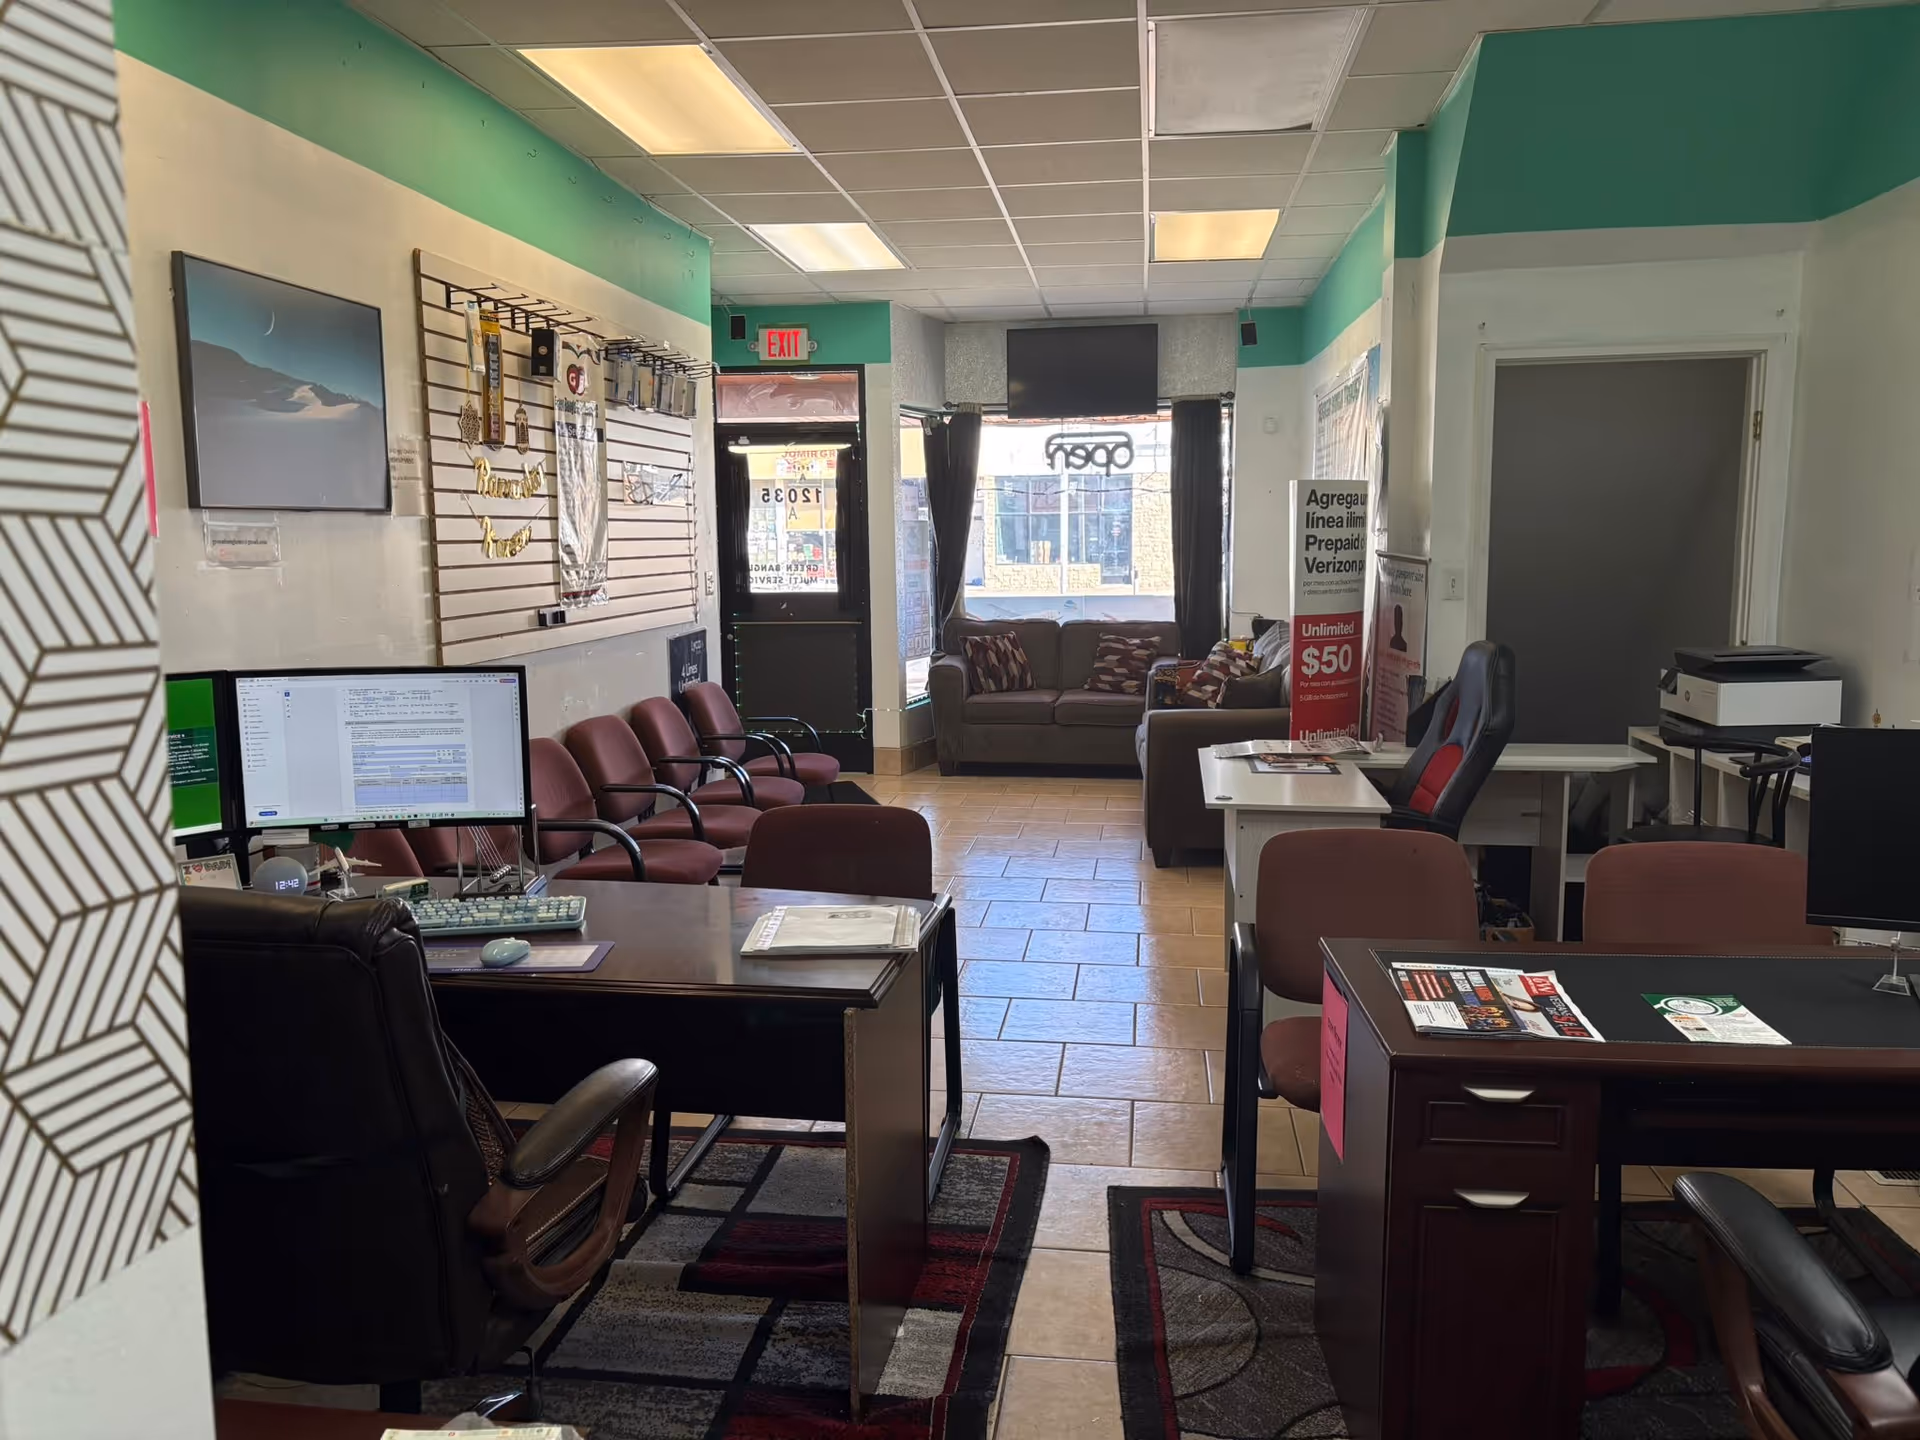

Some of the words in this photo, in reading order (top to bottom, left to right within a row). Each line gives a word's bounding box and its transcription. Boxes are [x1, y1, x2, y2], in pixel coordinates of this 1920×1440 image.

[767, 330, 802, 358] EXIT
[1306, 489, 1359, 509] Agrega
[1305, 511, 1344, 529] línea
[1305, 533, 1359, 554] Prepaid
[1304, 557, 1357, 573] Verizon
[1302, 621, 1354, 637] Unlimited
[1301, 644, 1353, 678] $50
[275, 879, 299, 890] 12:42
